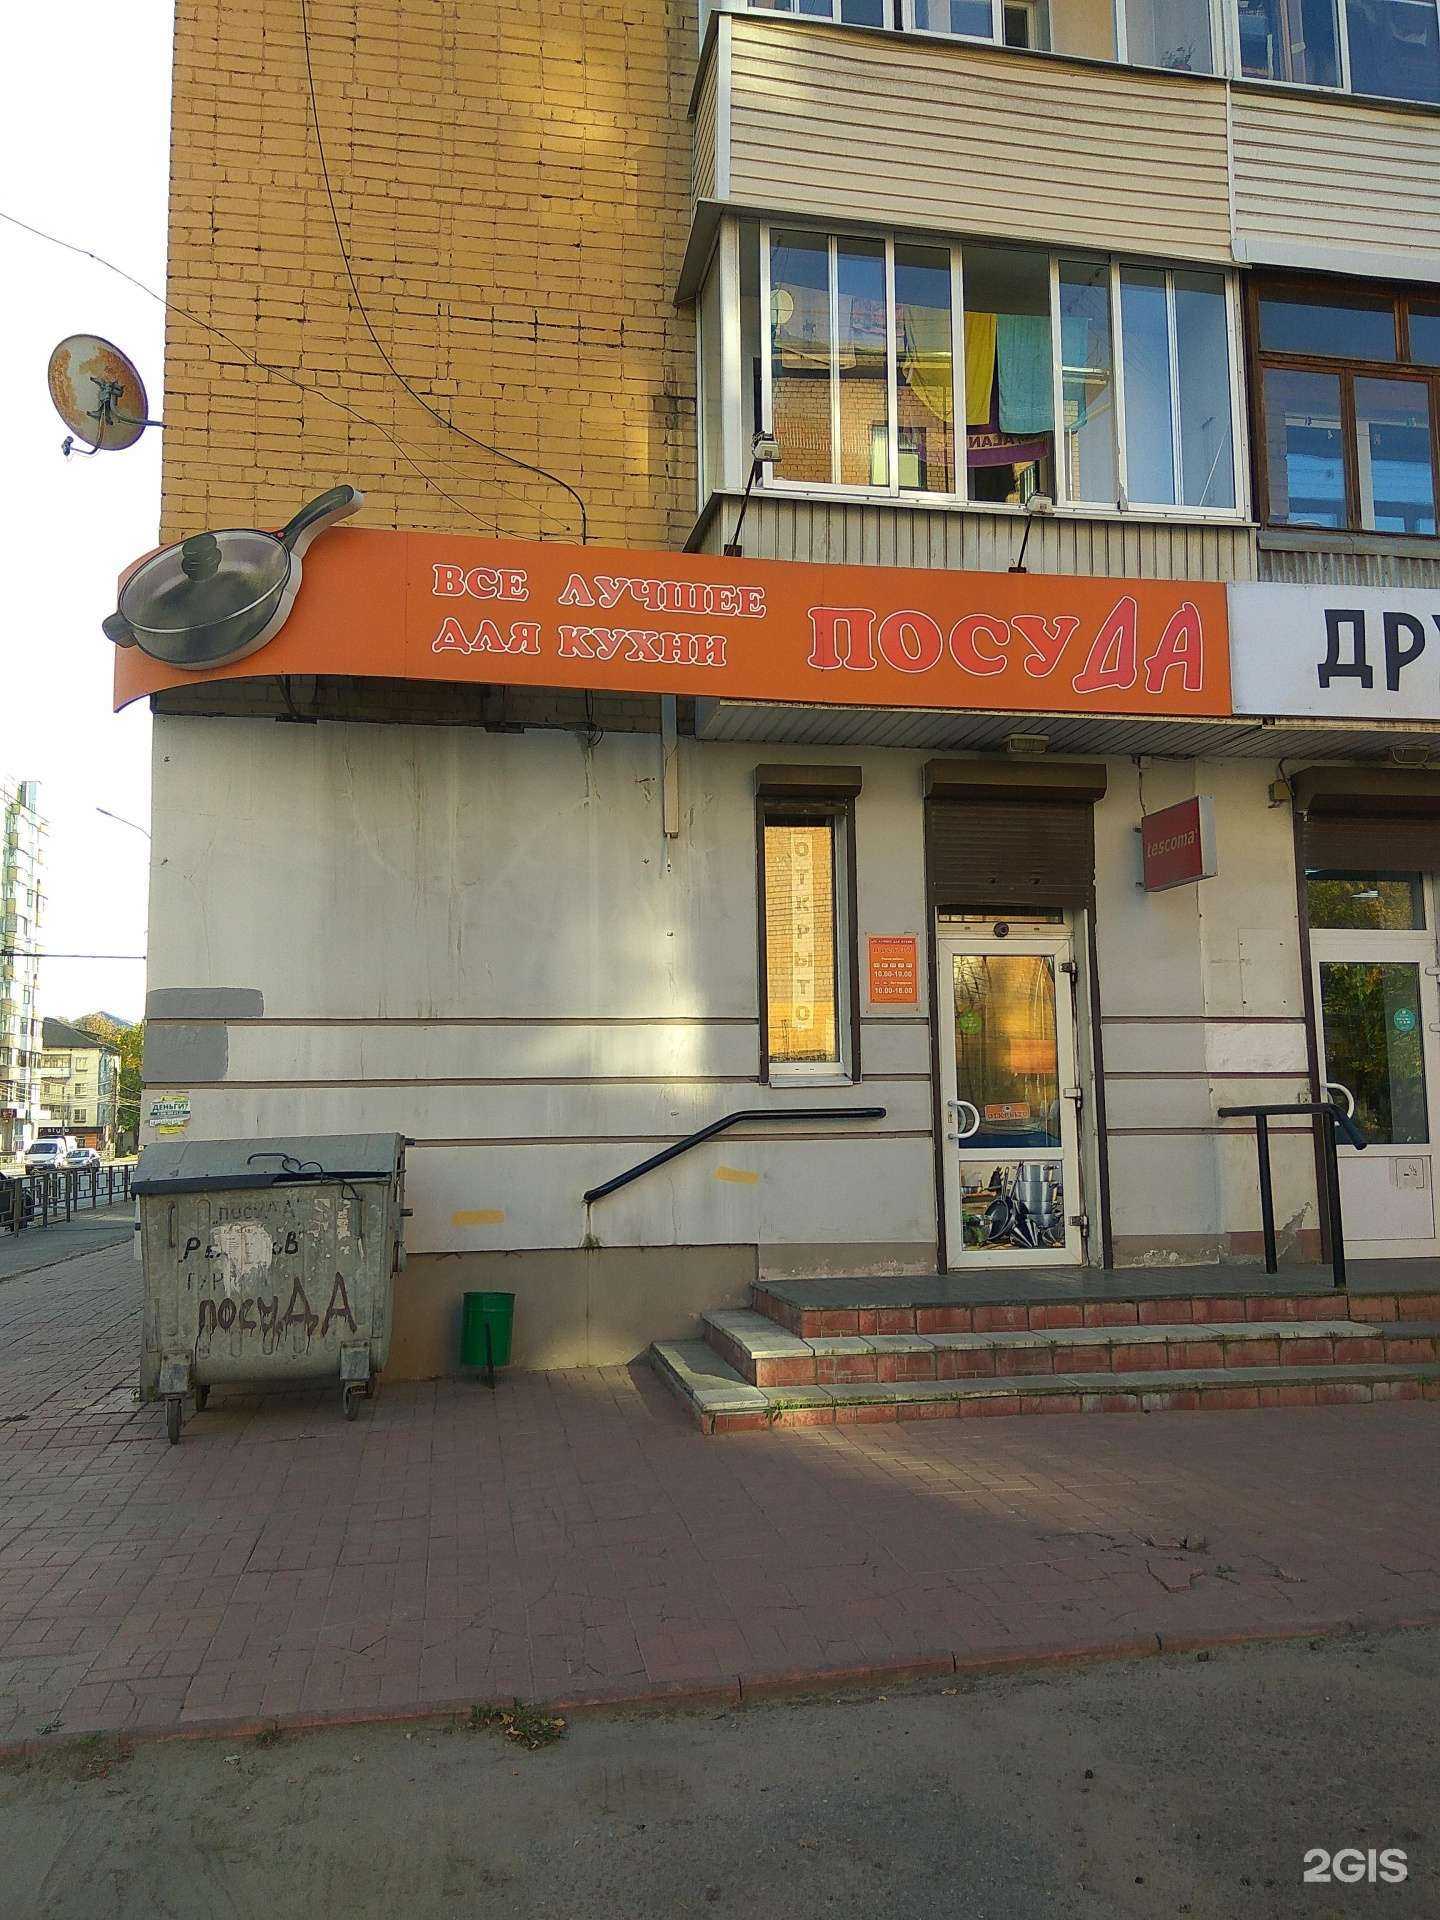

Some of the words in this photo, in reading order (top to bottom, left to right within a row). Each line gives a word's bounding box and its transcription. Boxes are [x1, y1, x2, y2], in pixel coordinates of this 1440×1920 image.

[432, 564, 530, 601] ВСЕ
[557, 573, 768, 618] ЛУЧШЕЕ
[431, 617, 541, 655] ДЛЯ
[557, 625, 727, 667] КУХНИ
[807, 596, 1204, 695] ПОСУДА
[1317, 608, 1440, 692] ДР
[1146, 830, 1196, 858] tescoma
[793, 840, 813, 1022] ОТКРЫТО
[198, 1271, 358, 1343] ПОСУДА
